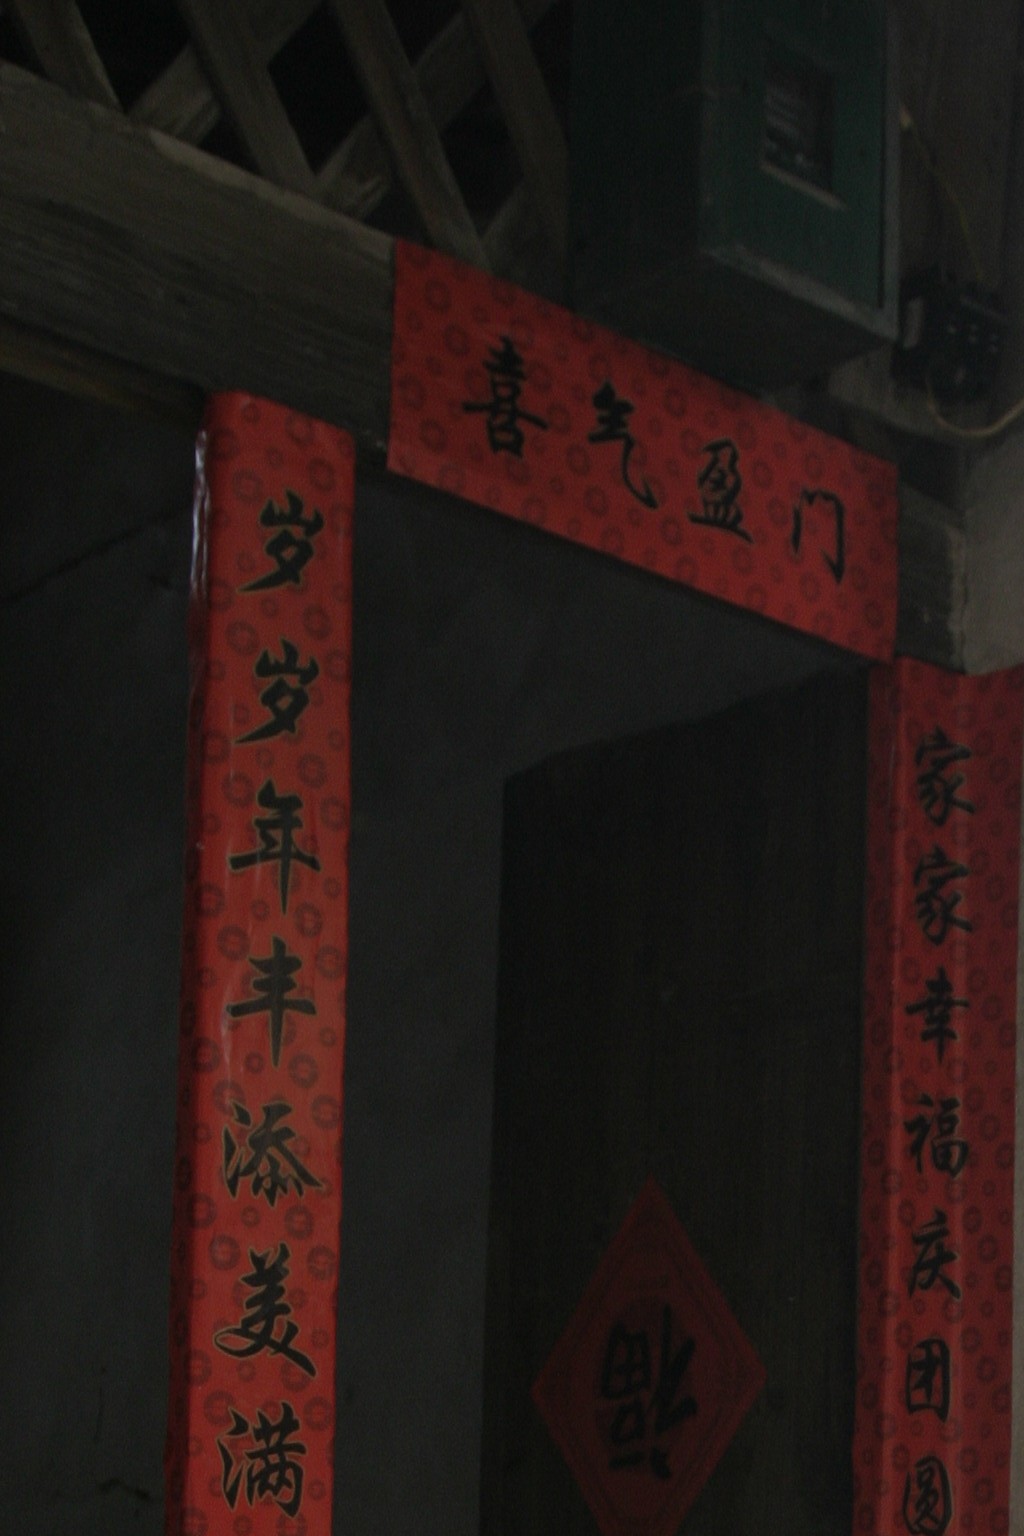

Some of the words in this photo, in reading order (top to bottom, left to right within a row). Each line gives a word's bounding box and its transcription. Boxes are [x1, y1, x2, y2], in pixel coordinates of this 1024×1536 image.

[463, 336, 846, 584] 喜气盈门
[212, 488, 326, 1518] 岁岁年丰添美满
[602, 1302, 700, 1482] 福
